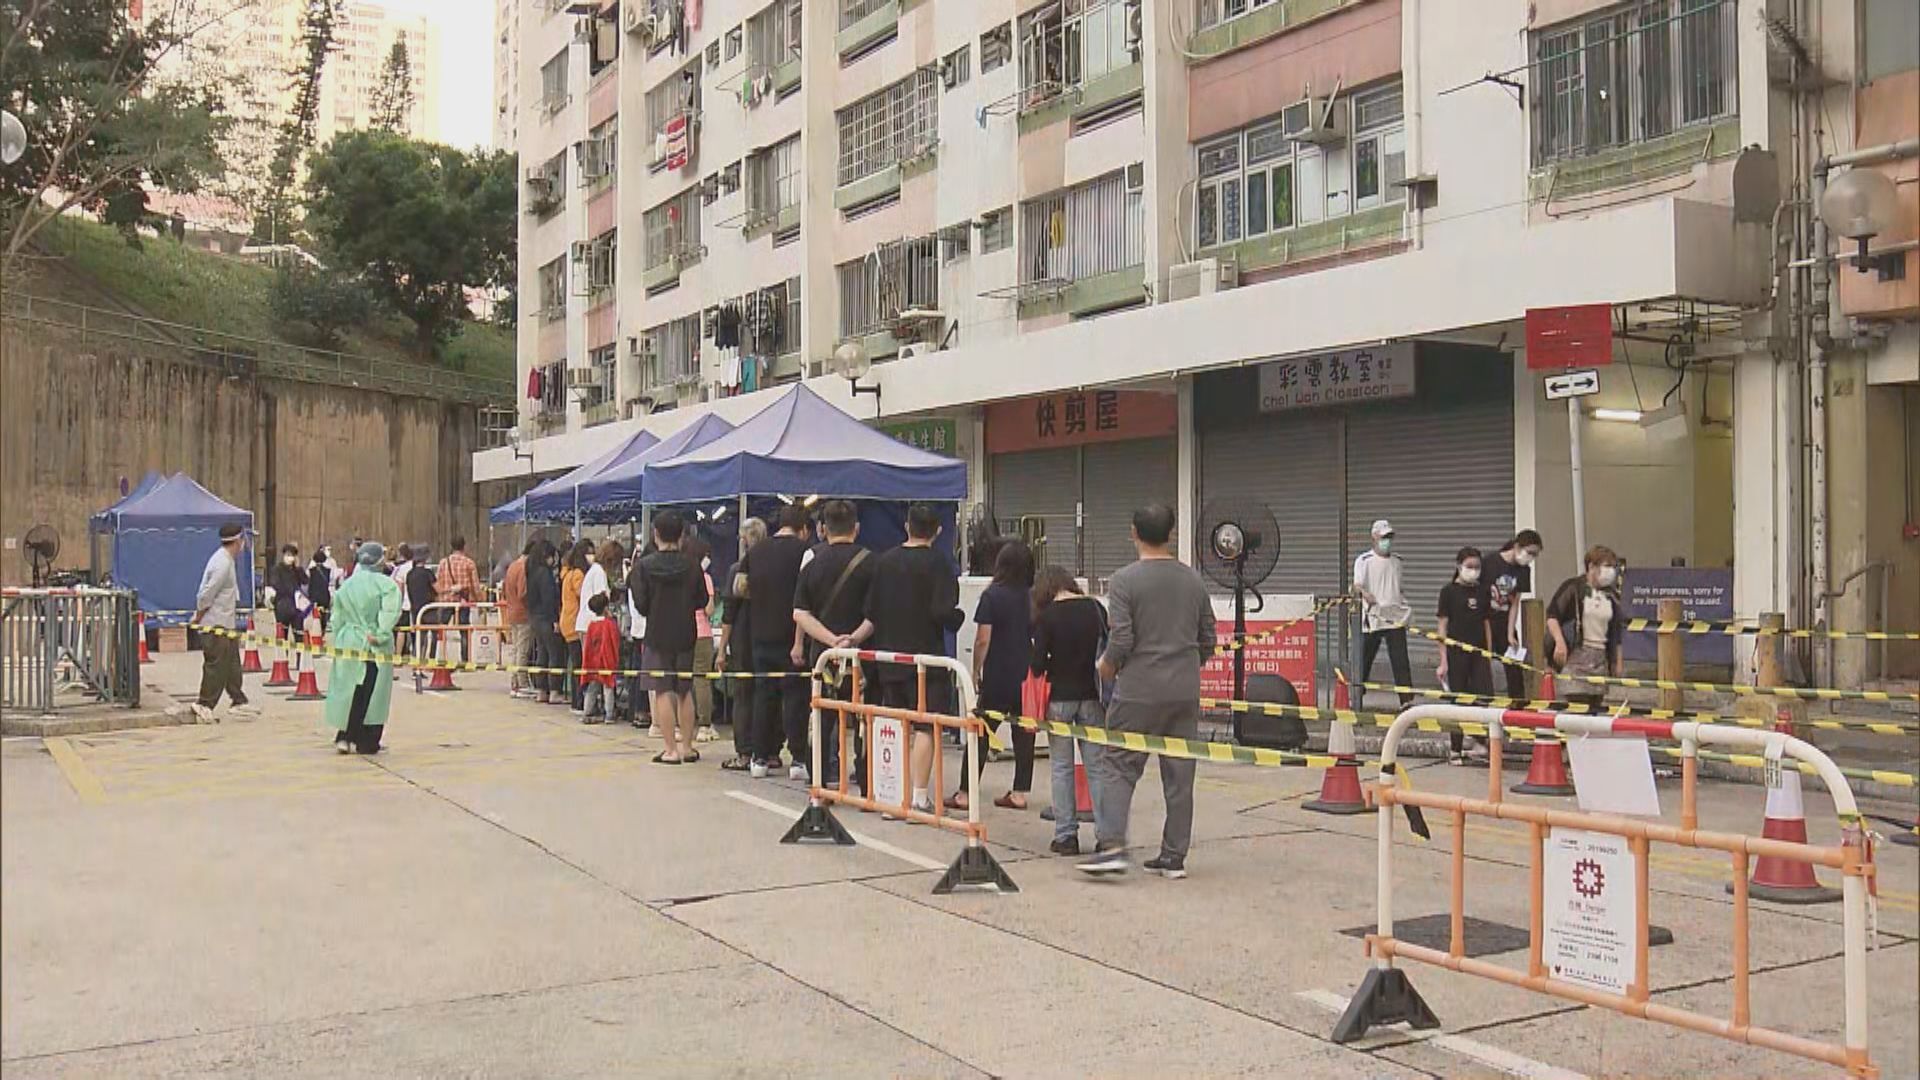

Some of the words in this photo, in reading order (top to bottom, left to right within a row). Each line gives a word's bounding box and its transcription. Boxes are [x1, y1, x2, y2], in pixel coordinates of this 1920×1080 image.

[1279, 352, 1373, 391] 彩雲教室
[1295, 392, 1320, 404] Wan
[1325, 384, 1390, 400] Classroom
[1036, 390, 1119, 437] 快剪屋
[1633, 586, 1650, 594] Work
[1652, 586, 1659, 594] in
[1660, 587, 1691, 596] progress,
[1693, 588, 1710, 596] sorry
[1713, 586, 1724, 594] for
